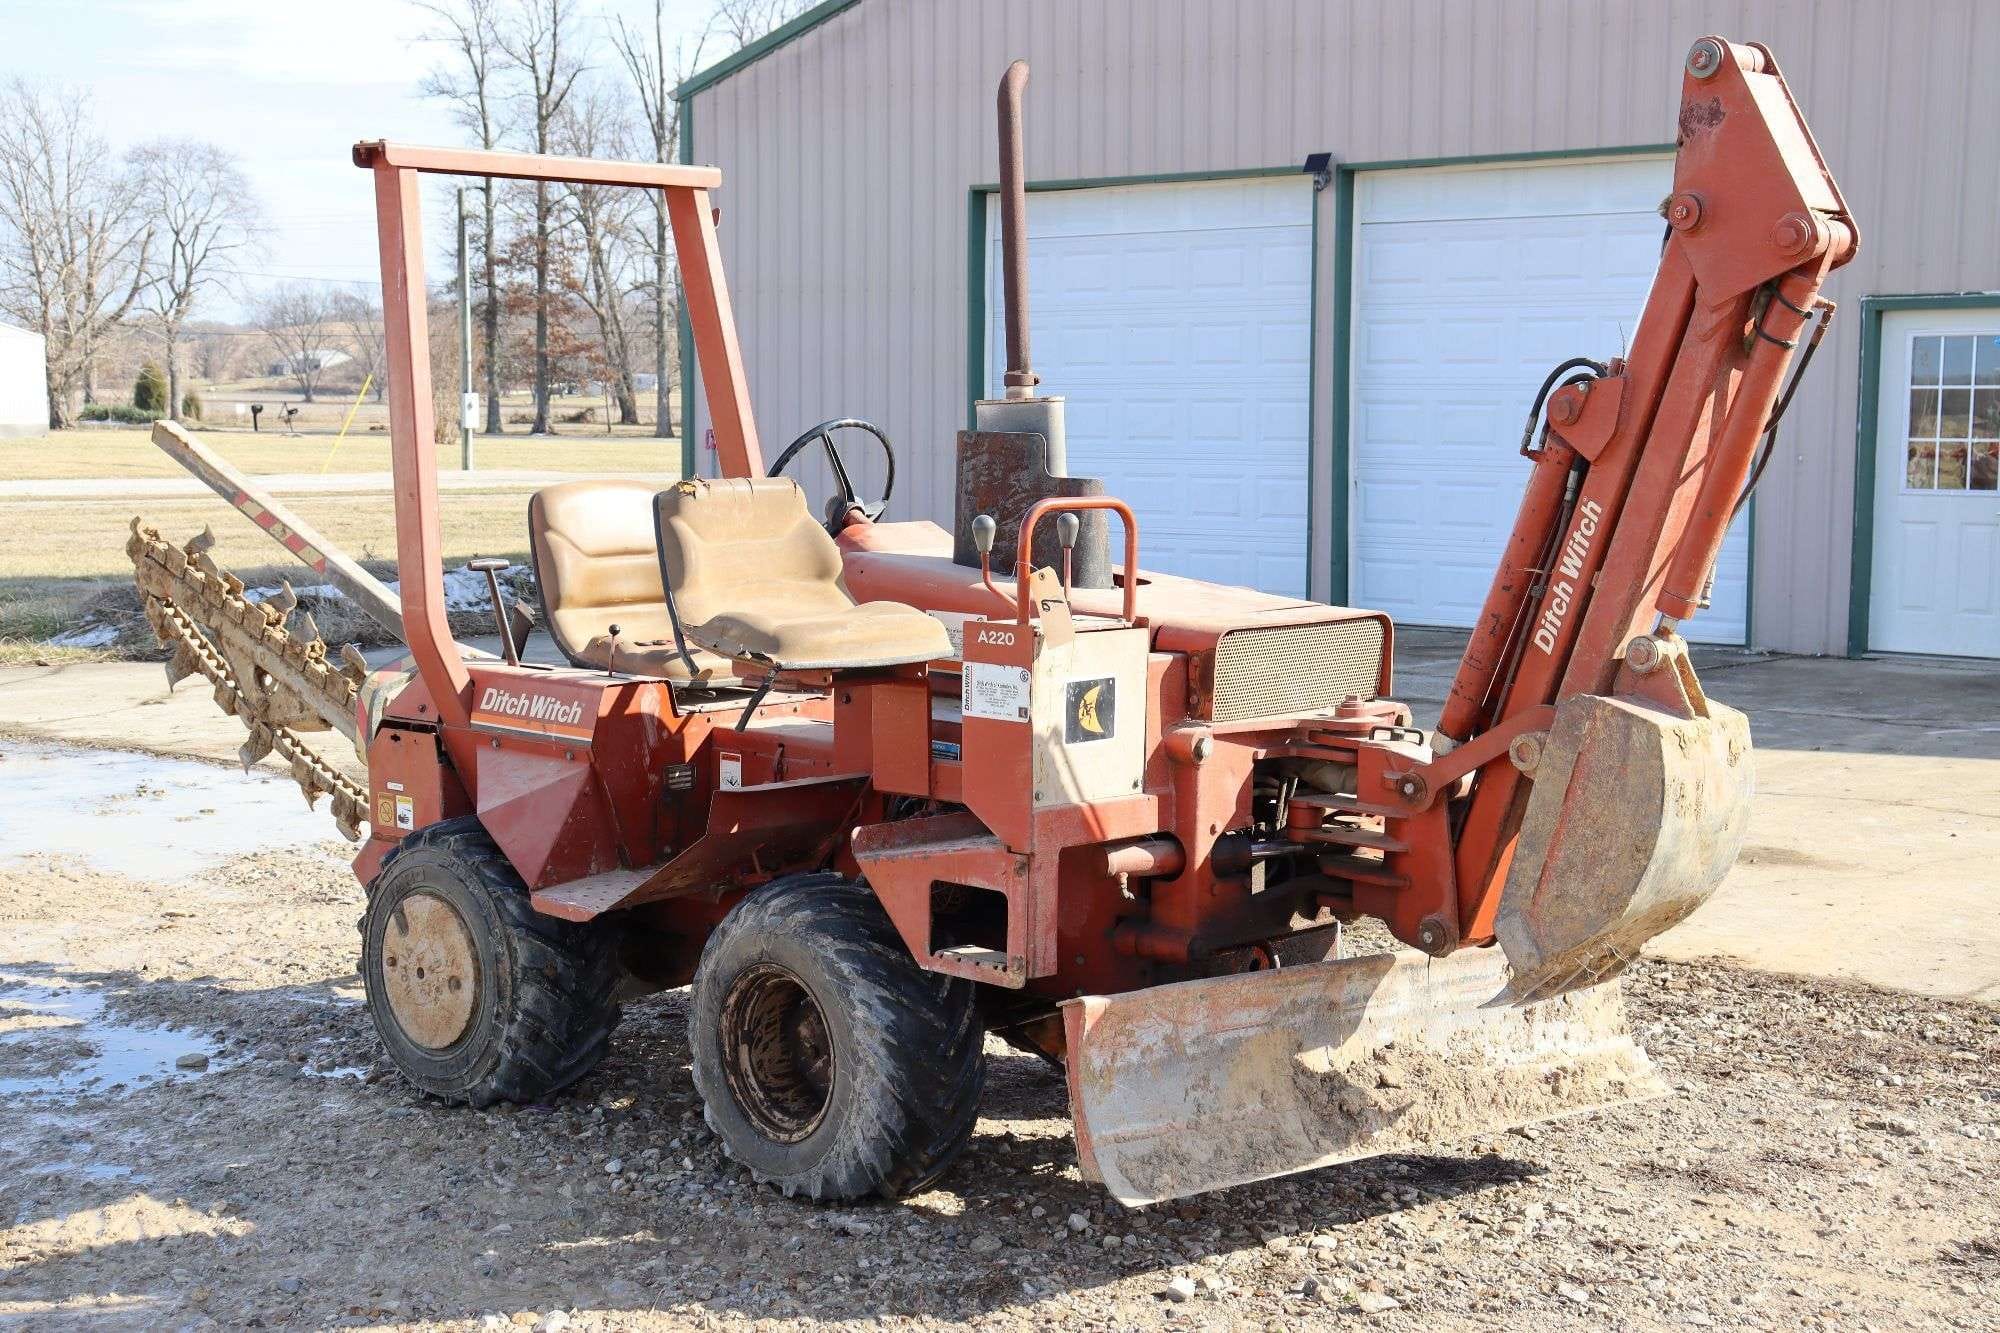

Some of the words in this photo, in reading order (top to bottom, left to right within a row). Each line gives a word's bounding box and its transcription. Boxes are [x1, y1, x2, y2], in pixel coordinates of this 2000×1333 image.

[1533, 580, 1574, 656] Ditch
[1559, 499, 1602, 580] Witch
[977, 629, 1015, 646] A220
